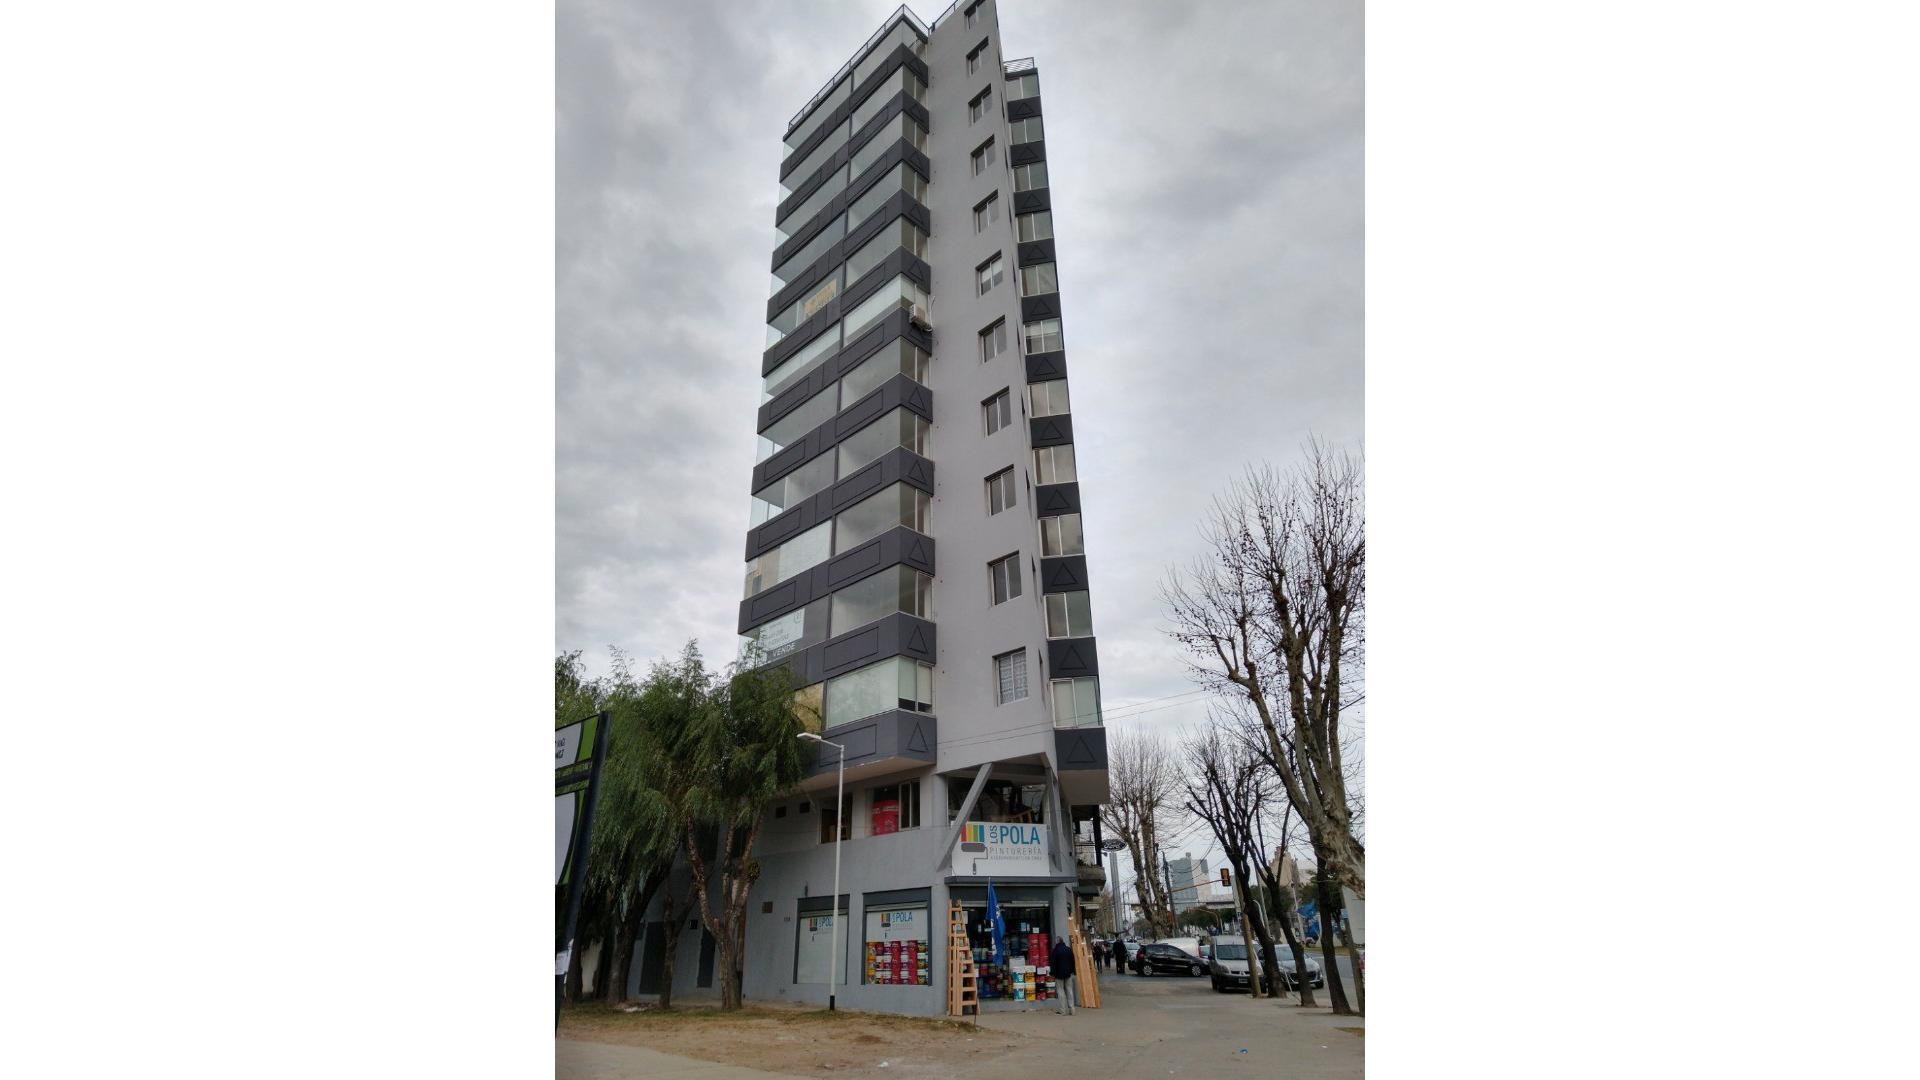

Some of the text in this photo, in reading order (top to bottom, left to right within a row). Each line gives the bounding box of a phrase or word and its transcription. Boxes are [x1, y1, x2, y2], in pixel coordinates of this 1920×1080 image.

[989, 825, 1041, 845] LOS POLA
[896, 911, 913, 922] POLA
